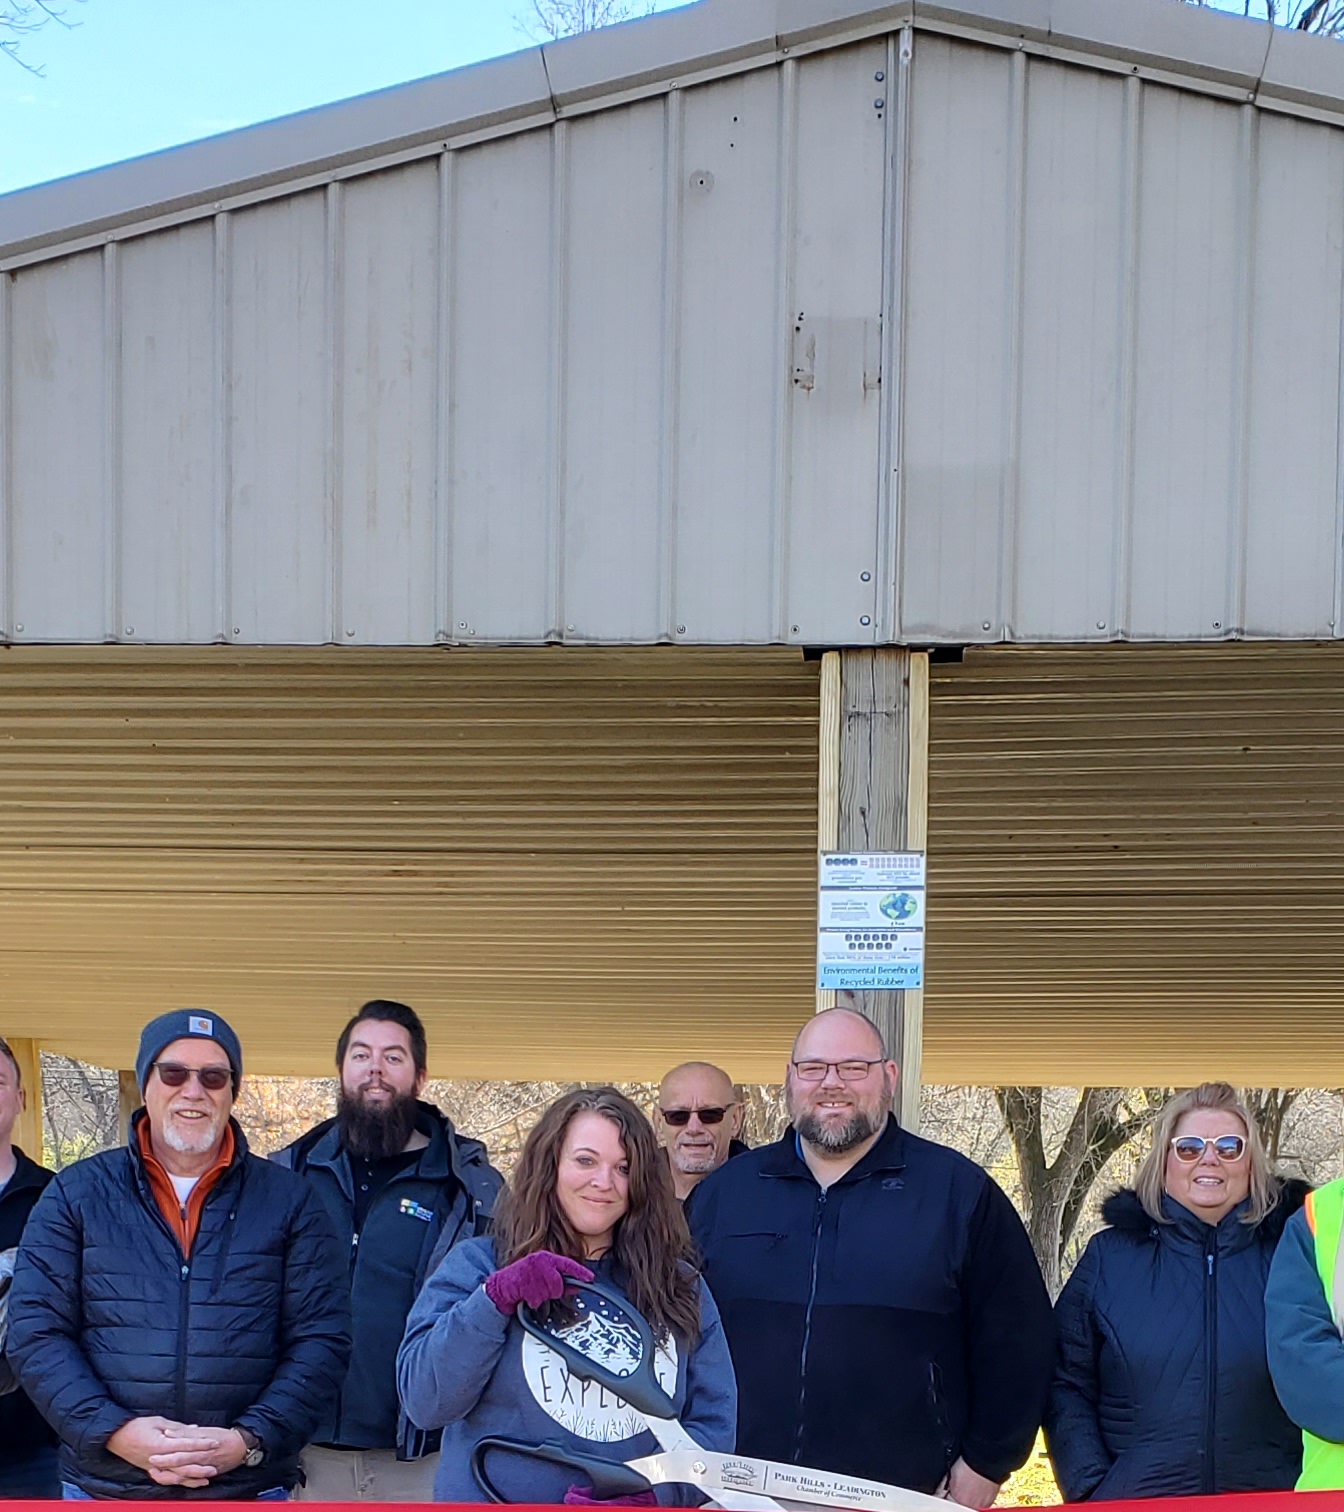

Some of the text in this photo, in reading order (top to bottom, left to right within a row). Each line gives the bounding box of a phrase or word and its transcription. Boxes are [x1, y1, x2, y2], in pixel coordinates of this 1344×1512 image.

[823, 966, 919, 975] Environmental Benefits of
[839, 977, 875, 987] Recycled
[774, 1472, 798, 1484] PARK
[800, 1476, 825, 1488] HILLS
[833, 1482, 887, 1498] LEADINGTON
[796, 1484, 824, 1497] Chamber
